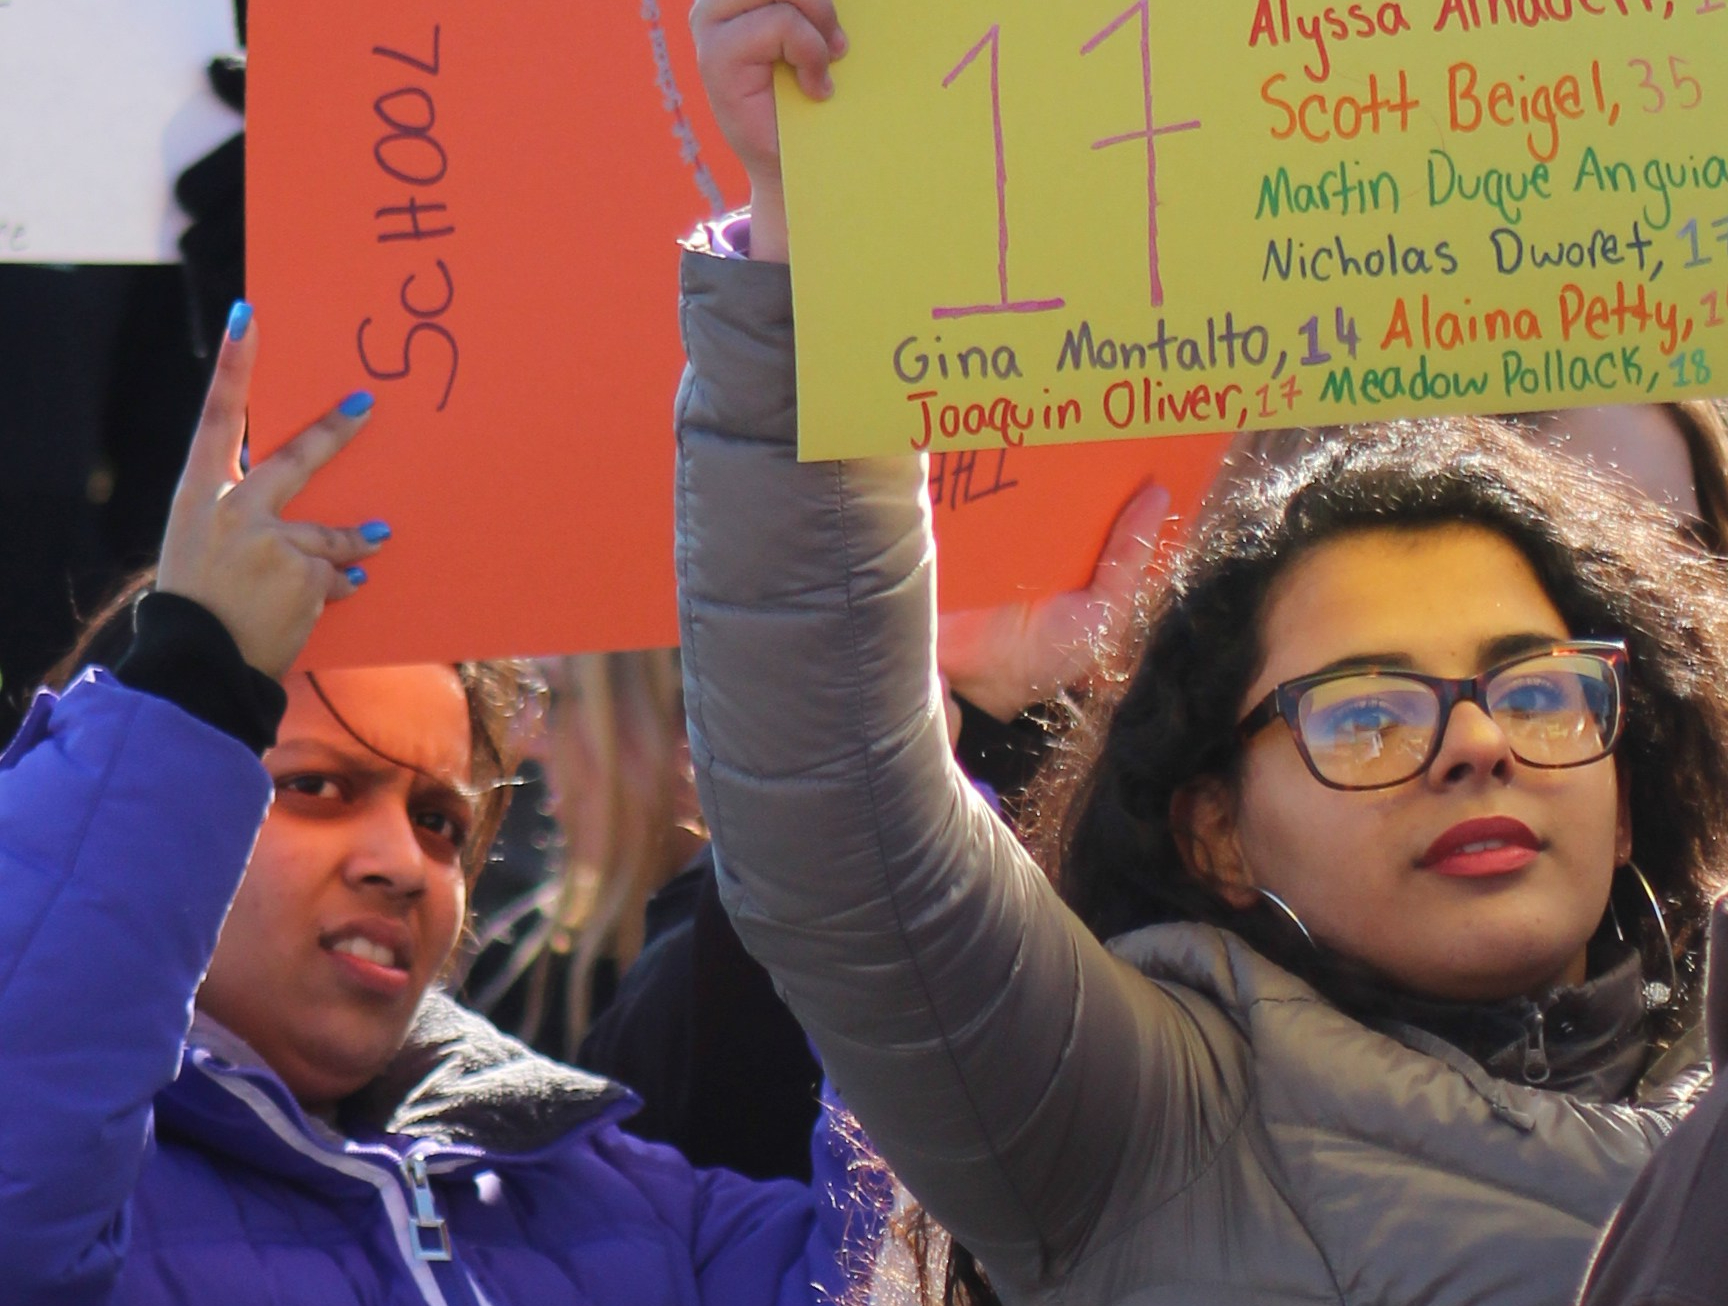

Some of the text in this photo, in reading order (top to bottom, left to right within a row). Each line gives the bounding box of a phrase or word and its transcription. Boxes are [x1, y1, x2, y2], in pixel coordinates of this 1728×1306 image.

[1259, 55, 1703, 163] Scott Beigel, 35
[356, 23, 459, 412] SCHOOL
[1254, 159, 1400, 220] Martin
[1428, 148, 1551, 225] Duque
[1262, 235, 1458, 281] Nicholas
[893, 334, 1023, 384] Gina
[1299, 314, 1361, 366] 14
[1380, 293, 1542, 350] Alaina
[907, 388, 1081, 450] Joaquin
[1256, 374, 1302, 418] 17
[1319, 354, 1489, 405] Meadow
[1668, 347, 1712, 389] 18
